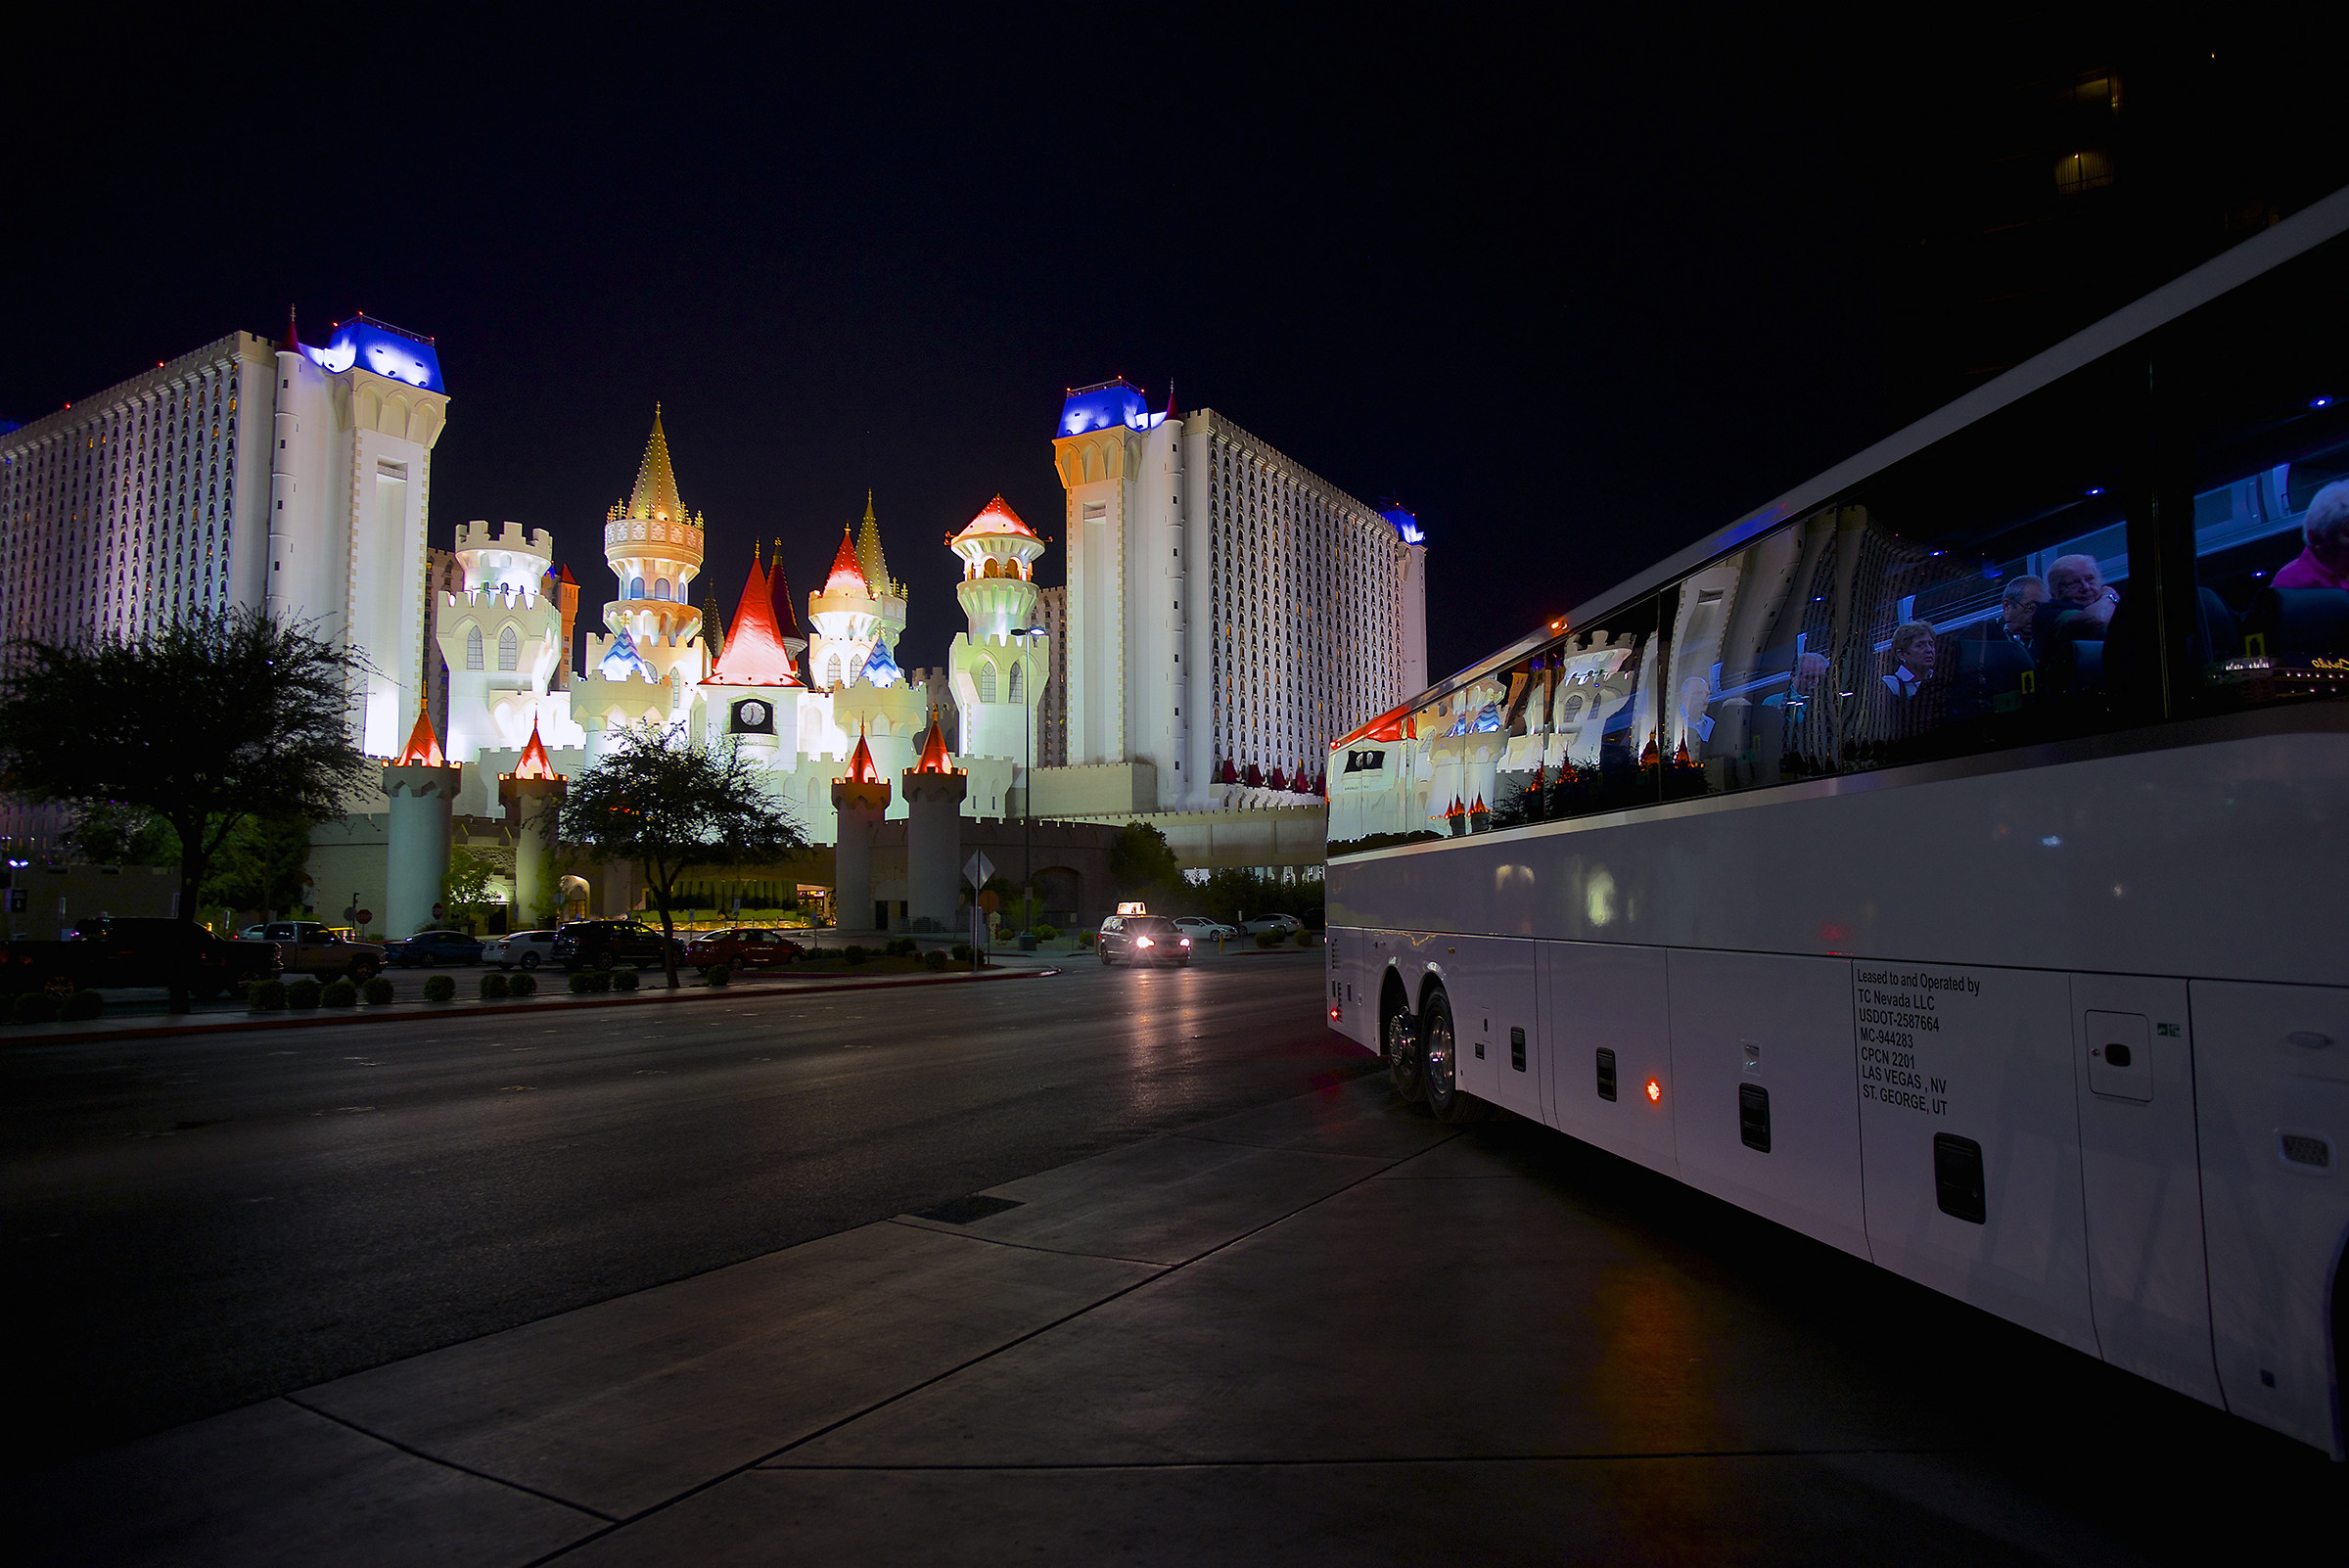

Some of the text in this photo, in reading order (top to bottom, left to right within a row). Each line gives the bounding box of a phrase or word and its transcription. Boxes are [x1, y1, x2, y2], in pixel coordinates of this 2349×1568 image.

[1858, 968, 1980, 996] Leased to and Operated by
[1859, 989, 1935, 1010] TC Nevada LLC
[1859, 1008, 1940, 1032] USDOT-2587664
[1860, 1027, 1913, 1048] MC-944283
[1861, 1046, 1915, 1069] CPCN 2201
[1862, 1064, 1882, 1082] LAS
[1931, 1078, 1947, 1094] NV
[1863, 1084, 1948, 1115] ST. GEORGE, UT
